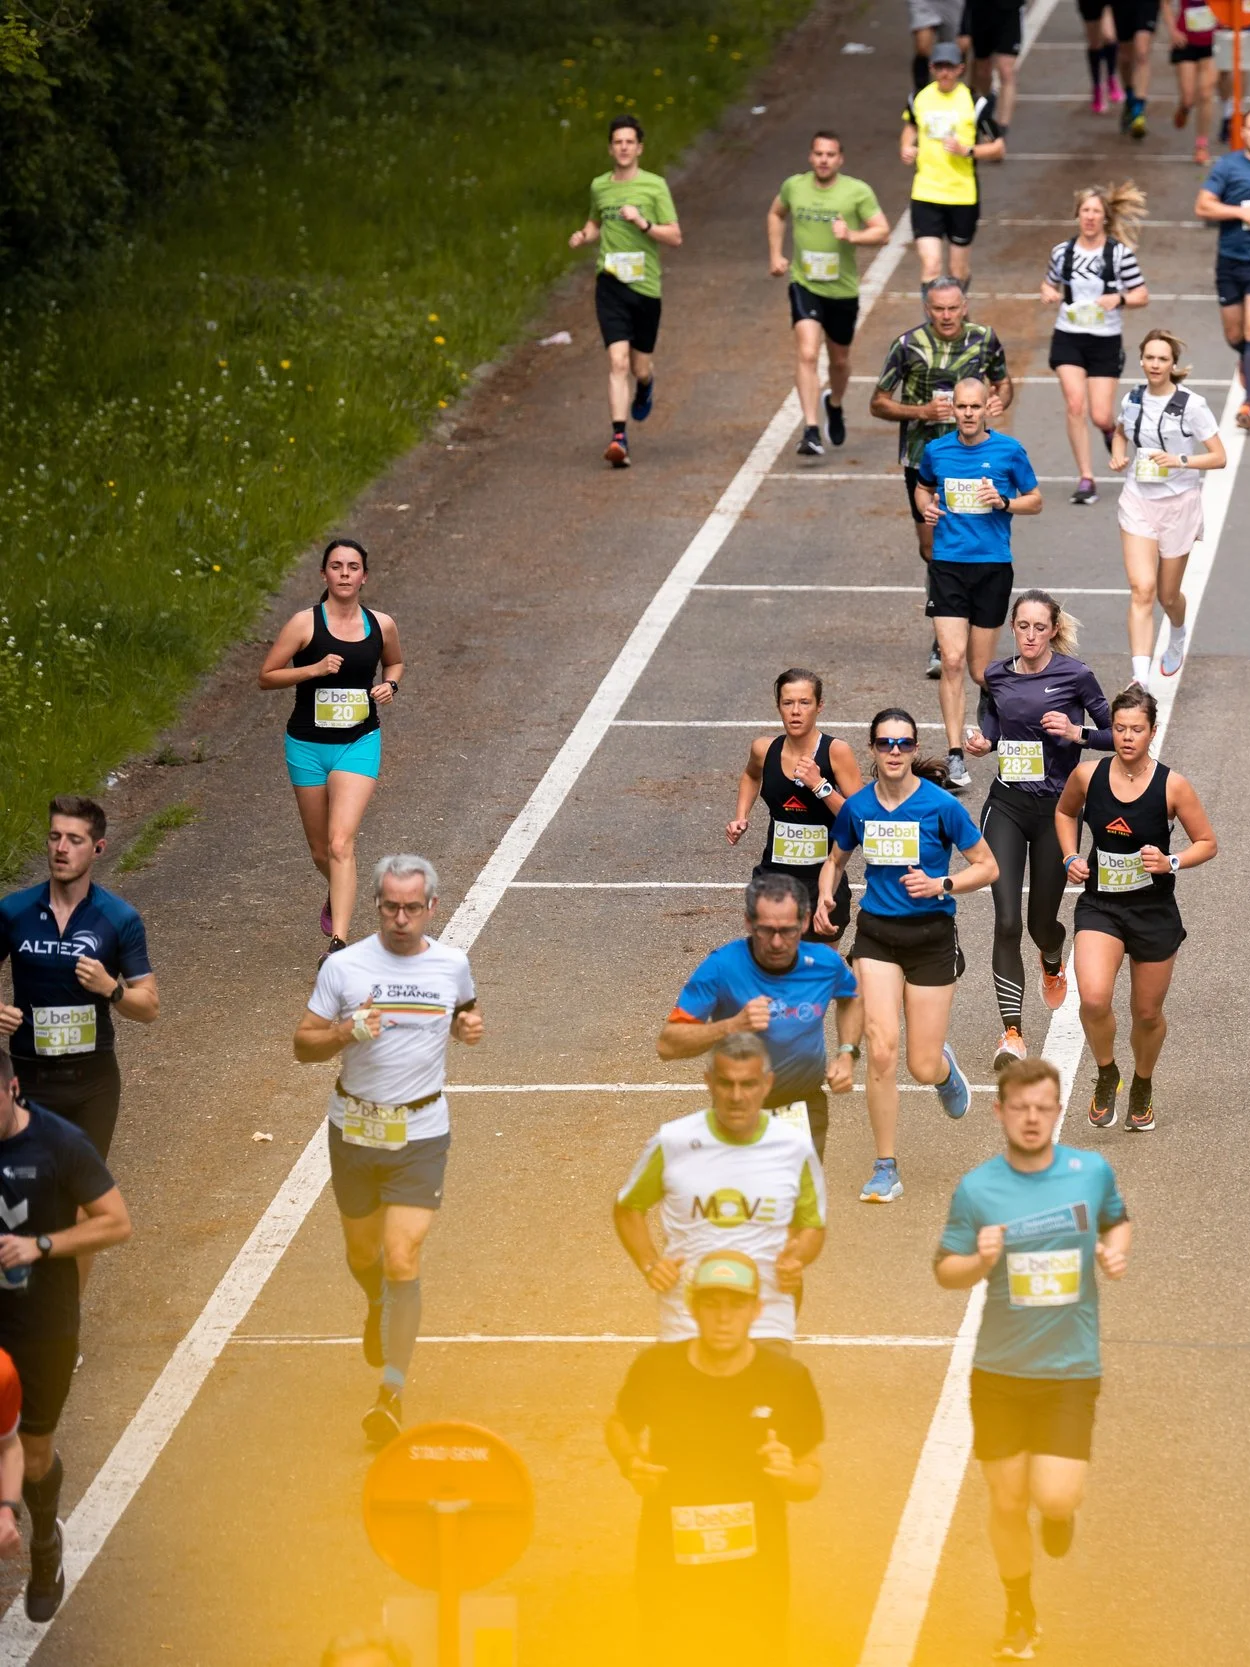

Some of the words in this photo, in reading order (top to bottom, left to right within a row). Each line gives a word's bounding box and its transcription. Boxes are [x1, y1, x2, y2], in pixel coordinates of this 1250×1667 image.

[331, 691, 369, 703] bebat
[332, 705, 353, 721] 20
[1007, 743, 1042, 756] bebat
[1003, 758, 1032, 774] 282
[787, 826, 827, 840] bebat
[878, 824, 917, 838] bebat
[784, 841, 815, 857] 278
[876, 840, 904, 857] 168
[1109, 856, 1141, 868] beba
[1108, 870, 1136, 885] 277
[19, 939, 86, 957] ALTEZ
[387, 989, 440, 999] CHANGE
[50, 1007, 95, 1025] bebat
[49, 1027, 81, 1046] 319
[364, 1120, 386, 1140] 36
[691, 1186, 776, 1229] MOVE
[1029, 1254, 1078, 1273] bebat
[1030, 1275, 1062, 1295] 84
[701, 1529, 728, 1553] 15
